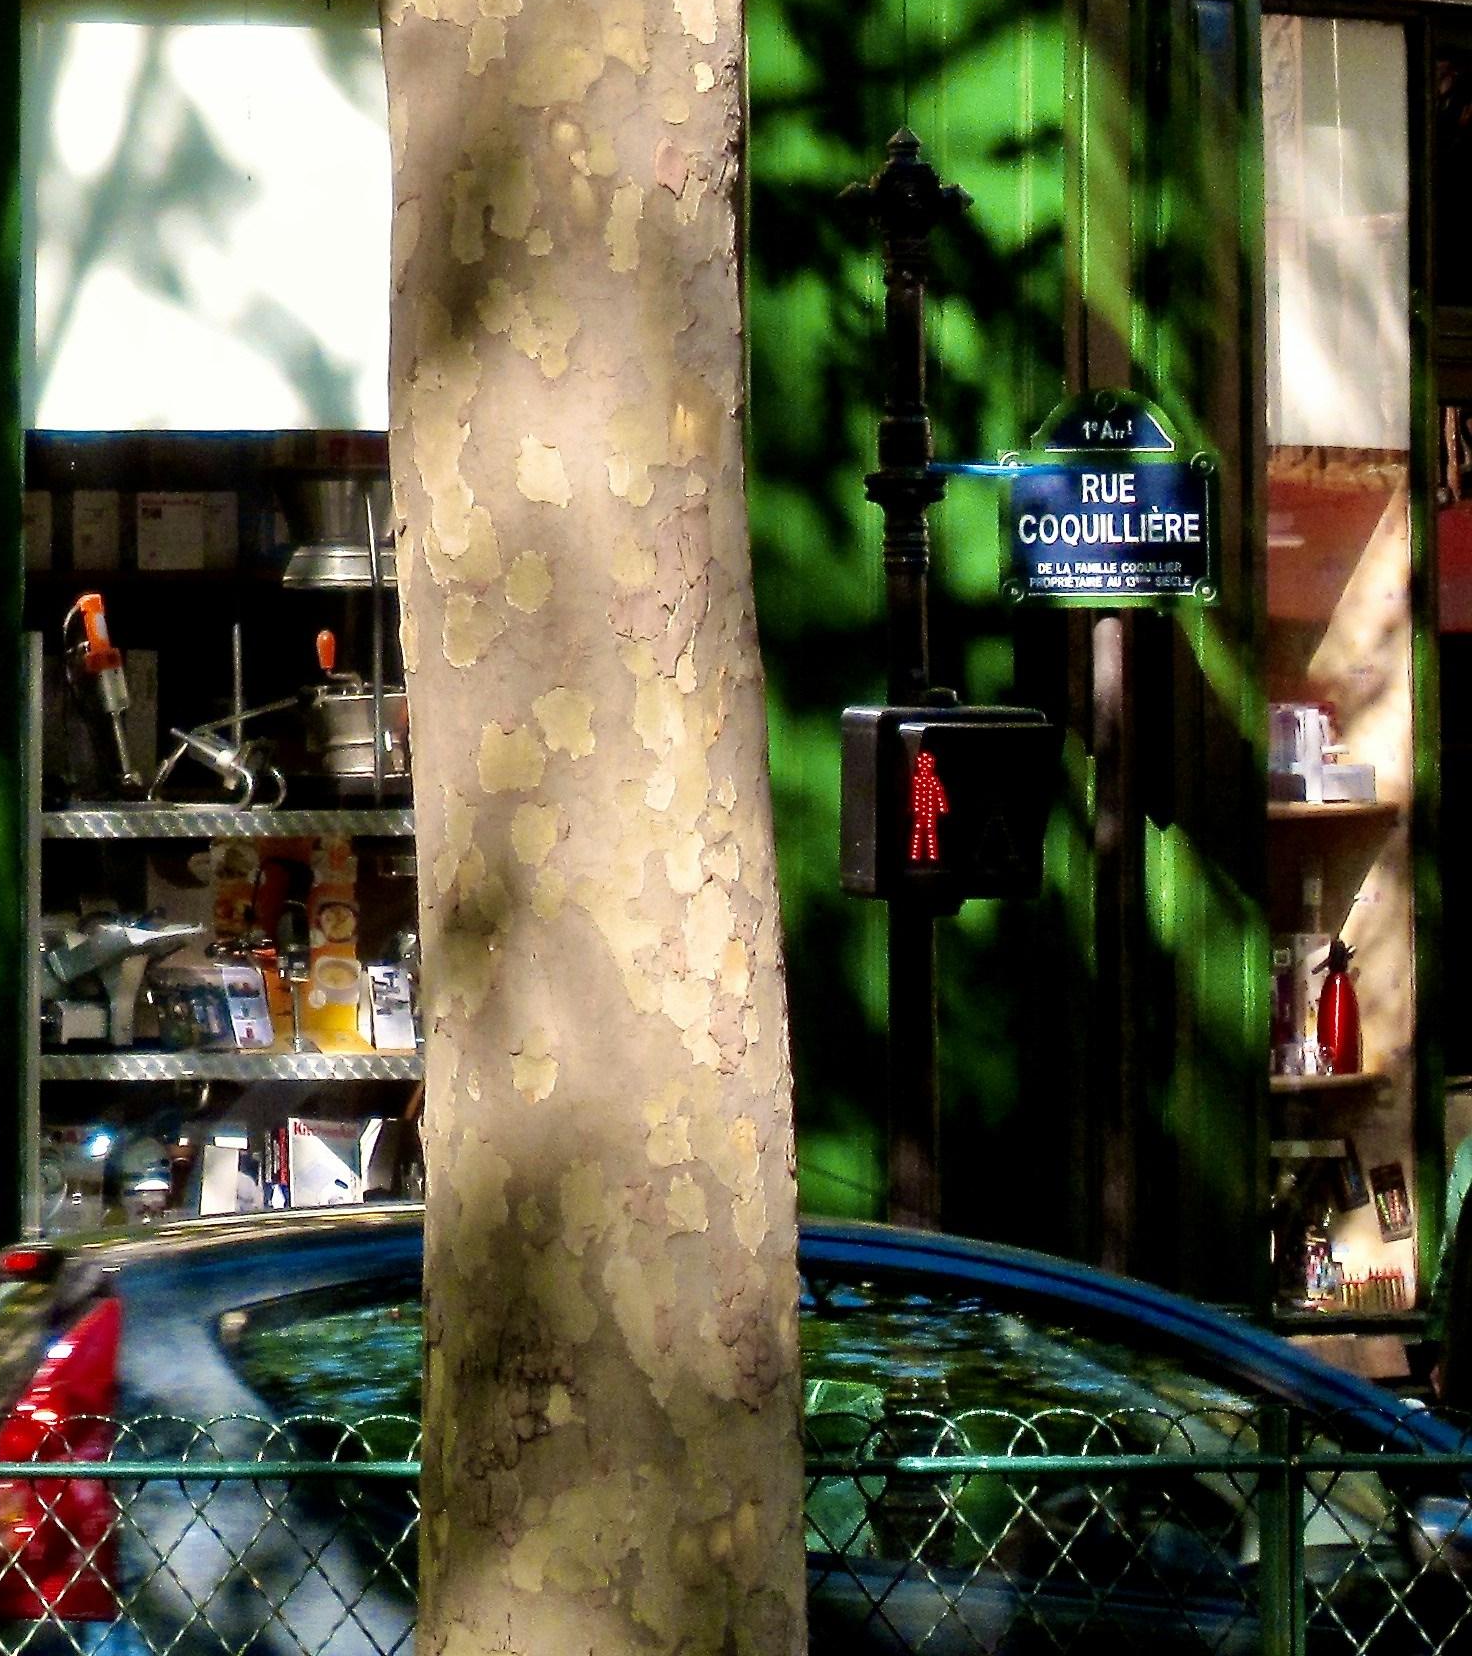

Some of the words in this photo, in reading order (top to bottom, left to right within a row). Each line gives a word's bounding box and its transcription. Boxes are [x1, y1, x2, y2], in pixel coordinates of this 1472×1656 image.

[1081, 473, 1136, 504] RUE
[1018, 506, 1201, 547] COQUILLIÈRE
[1037, 562, 1053, 575] DE
[1056, 562, 1070, 575] LA
[1074, 562, 1117, 574] FAMILLE
[1107, 576, 1122, 588] AU
